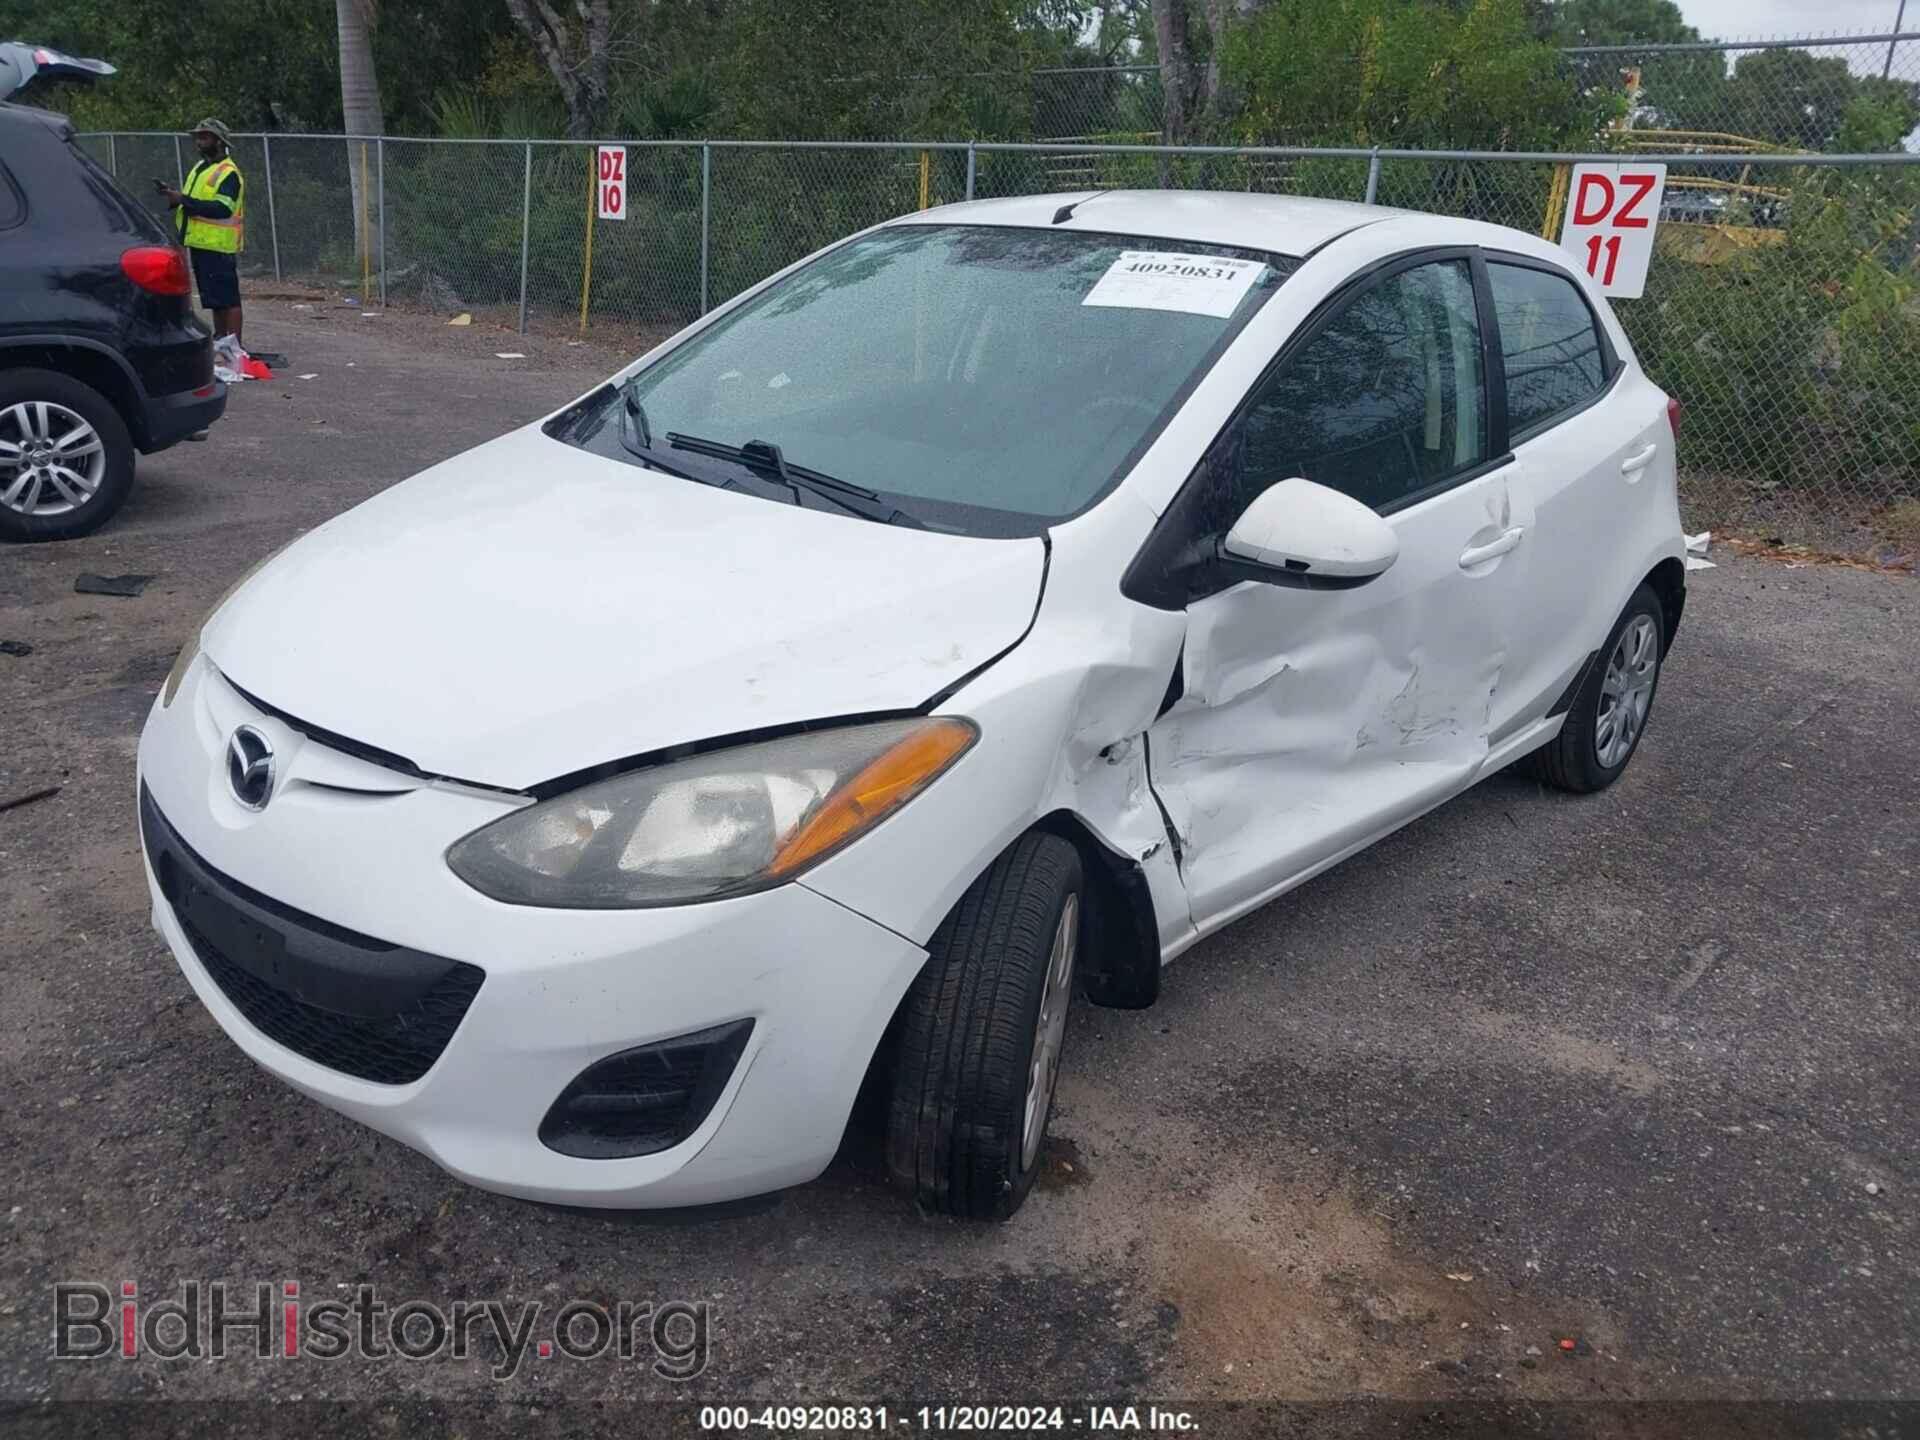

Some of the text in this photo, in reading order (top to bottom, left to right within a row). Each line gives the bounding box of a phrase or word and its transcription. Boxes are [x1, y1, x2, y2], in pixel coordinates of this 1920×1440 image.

[600, 151, 624, 181] DZ
[603, 184, 622, 214] 10
[1573, 173, 1657, 228] DZ
[1124, 262, 1237, 281] 40920831
[1586, 235, 1622, 286] 11
